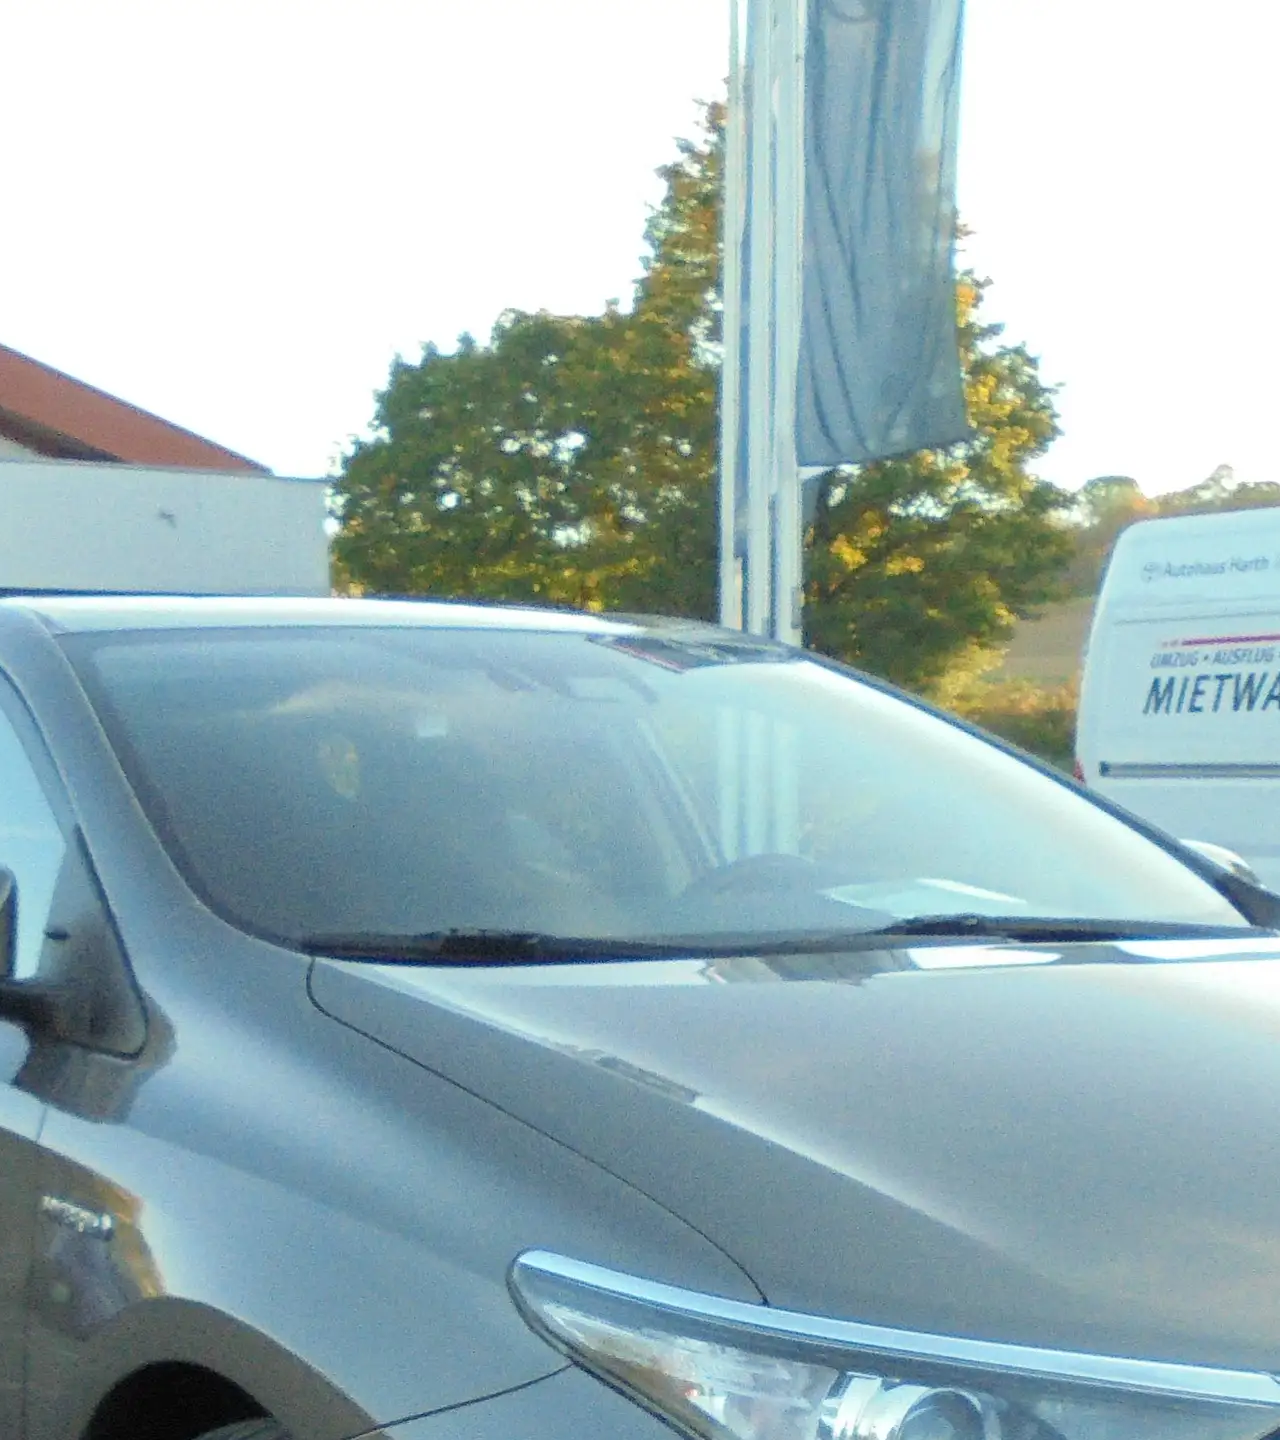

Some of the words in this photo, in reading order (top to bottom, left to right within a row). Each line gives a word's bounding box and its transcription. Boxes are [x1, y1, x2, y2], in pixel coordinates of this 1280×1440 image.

[1164, 559, 1226, 577] Autohaus
[1150, 652, 1199, 669] UMZUG
[1212, 647, 1276, 665] AUSFLUG
